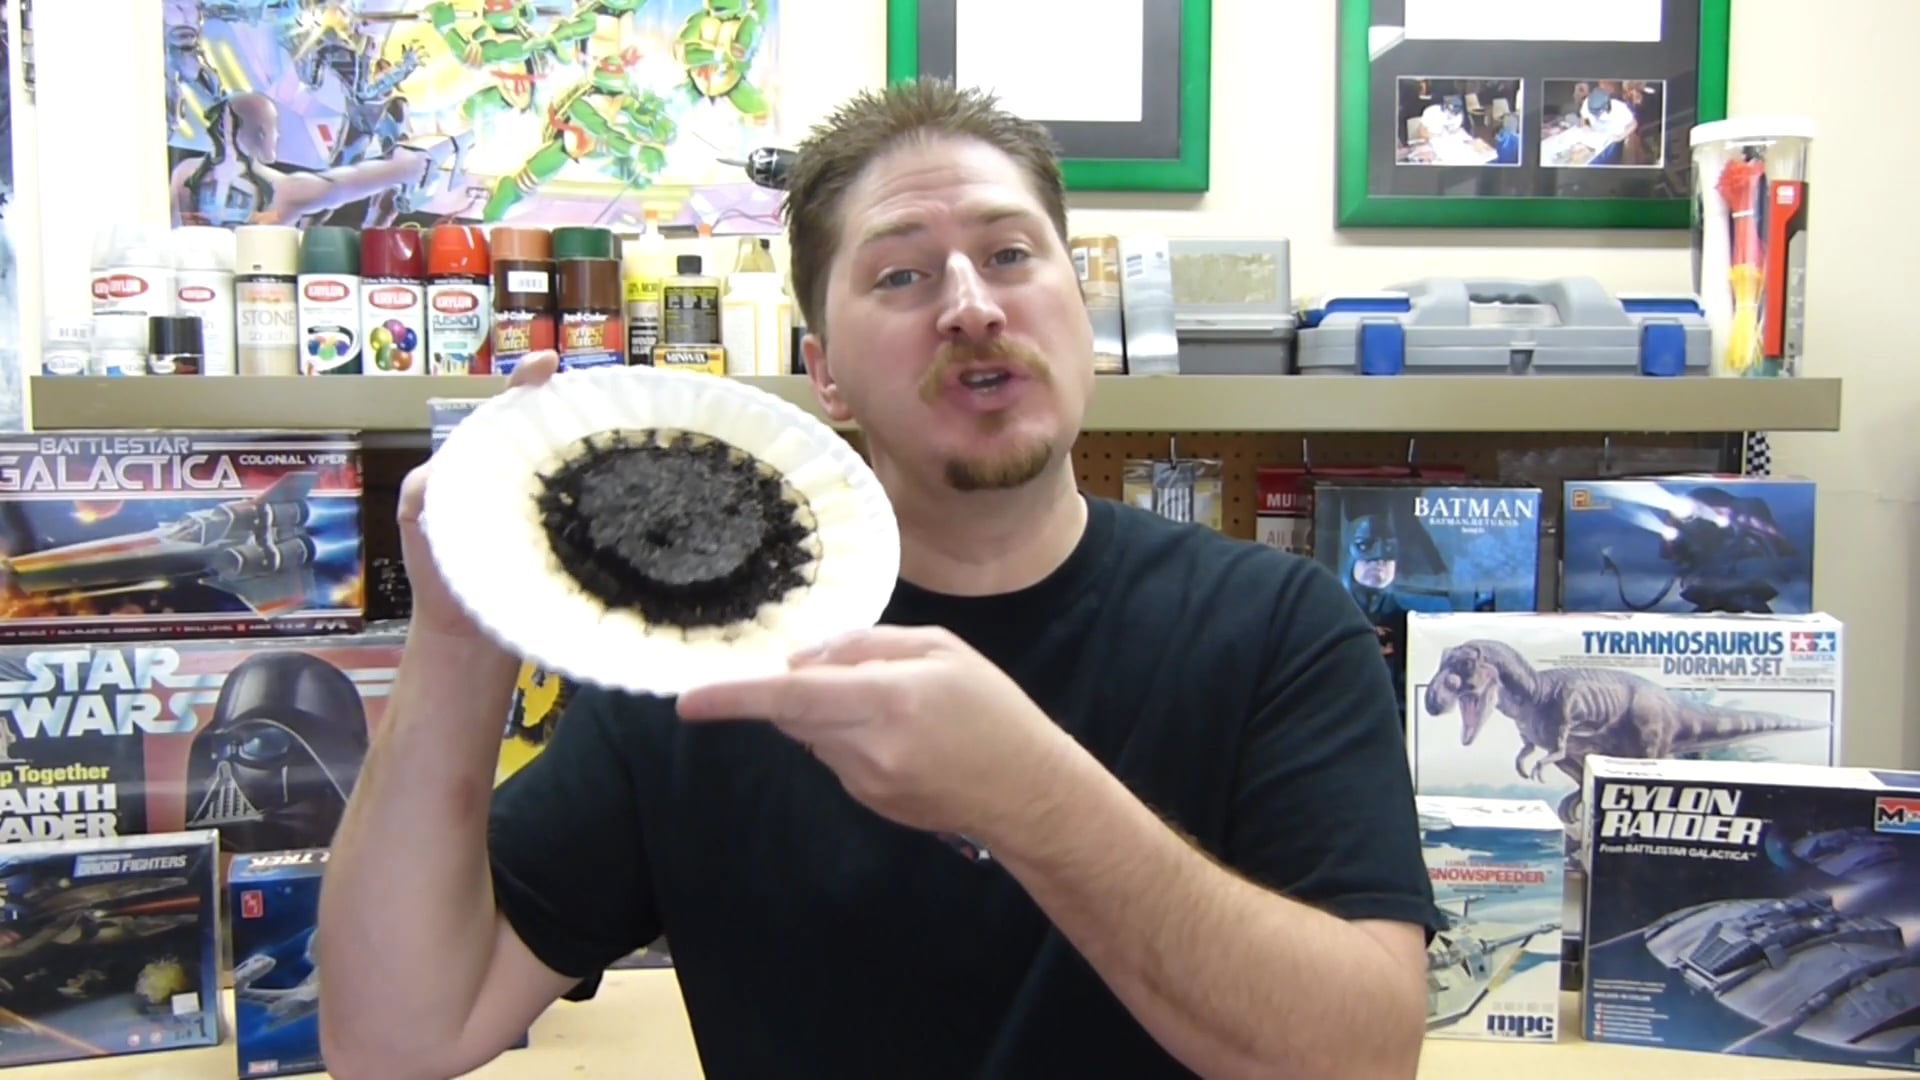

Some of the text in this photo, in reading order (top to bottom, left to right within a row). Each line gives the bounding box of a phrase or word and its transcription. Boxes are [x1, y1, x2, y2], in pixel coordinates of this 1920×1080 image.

[308, 285, 345, 297] KRYLON
[374, 291, 413, 305] KRYLON
[436, 295, 472, 308] KRYLON
[241, 309, 297, 326] STONE
[40, 437, 190, 454] BATTLESTAR
[239, 454, 347, 465] COLONIAL VIPER
[0, 455, 242, 490] GALACTICA
[1414, 497, 1533, 519] BATMAN
[1582, 631, 1785, 656] TYRANNOSAURUS
[25, 647, 180, 691] STAR
[1663, 657, 1747, 677] DIORAMA
[1750, 657, 1784, 677] SET
[10, 692, 197, 738] WARS
[14, 762, 110, 785] Together
[1600, 783, 1742, 816] CYLON
[1600, 810, 1764, 846] RAIDER
[1599, 843, 1749, 861] From BATTLESTAR GALACTICA
[78, 860, 119, 875] DROID
[121, 855, 188, 872] FIGHTERS
[1429, 867, 1546, 885] SNOWSPEEDER
[1487, 1014, 1555, 1039] mpc
